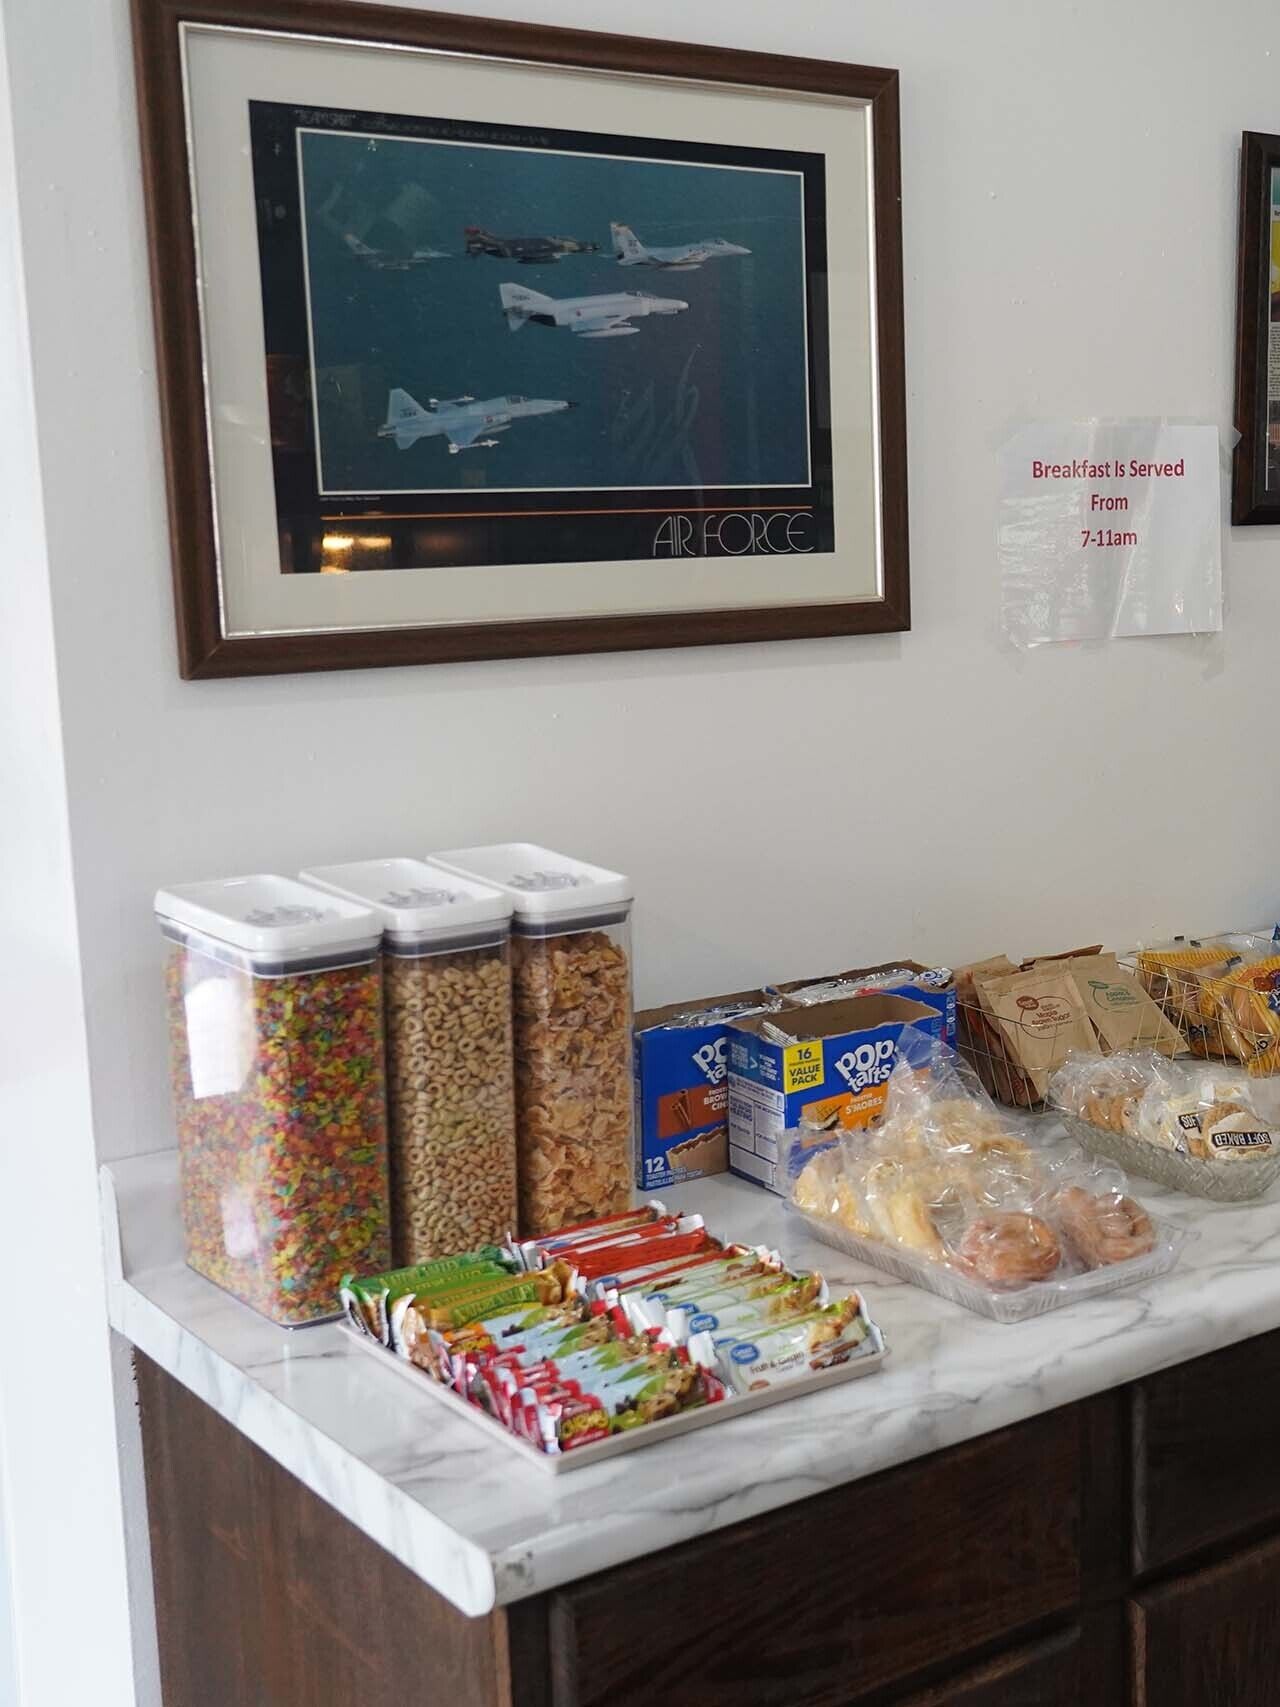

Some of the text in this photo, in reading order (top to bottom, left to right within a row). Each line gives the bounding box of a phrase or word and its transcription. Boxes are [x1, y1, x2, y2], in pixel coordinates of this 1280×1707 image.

[1032, 458, 1185, 479] Breakfast Is Served
[1091, 493, 1129, 512] From
[652, 512, 815, 557] AIR FORCE
[1081, 529, 1138, 548] 7-11am
[797, 1047, 812, 1061] 16
[789, 1064, 821, 1077] VALUE
[791, 1073, 819, 1086] PACK
[1214, 1133, 1271, 1146] SOFT BAKED
[645, 1156, 665, 1174] 12
